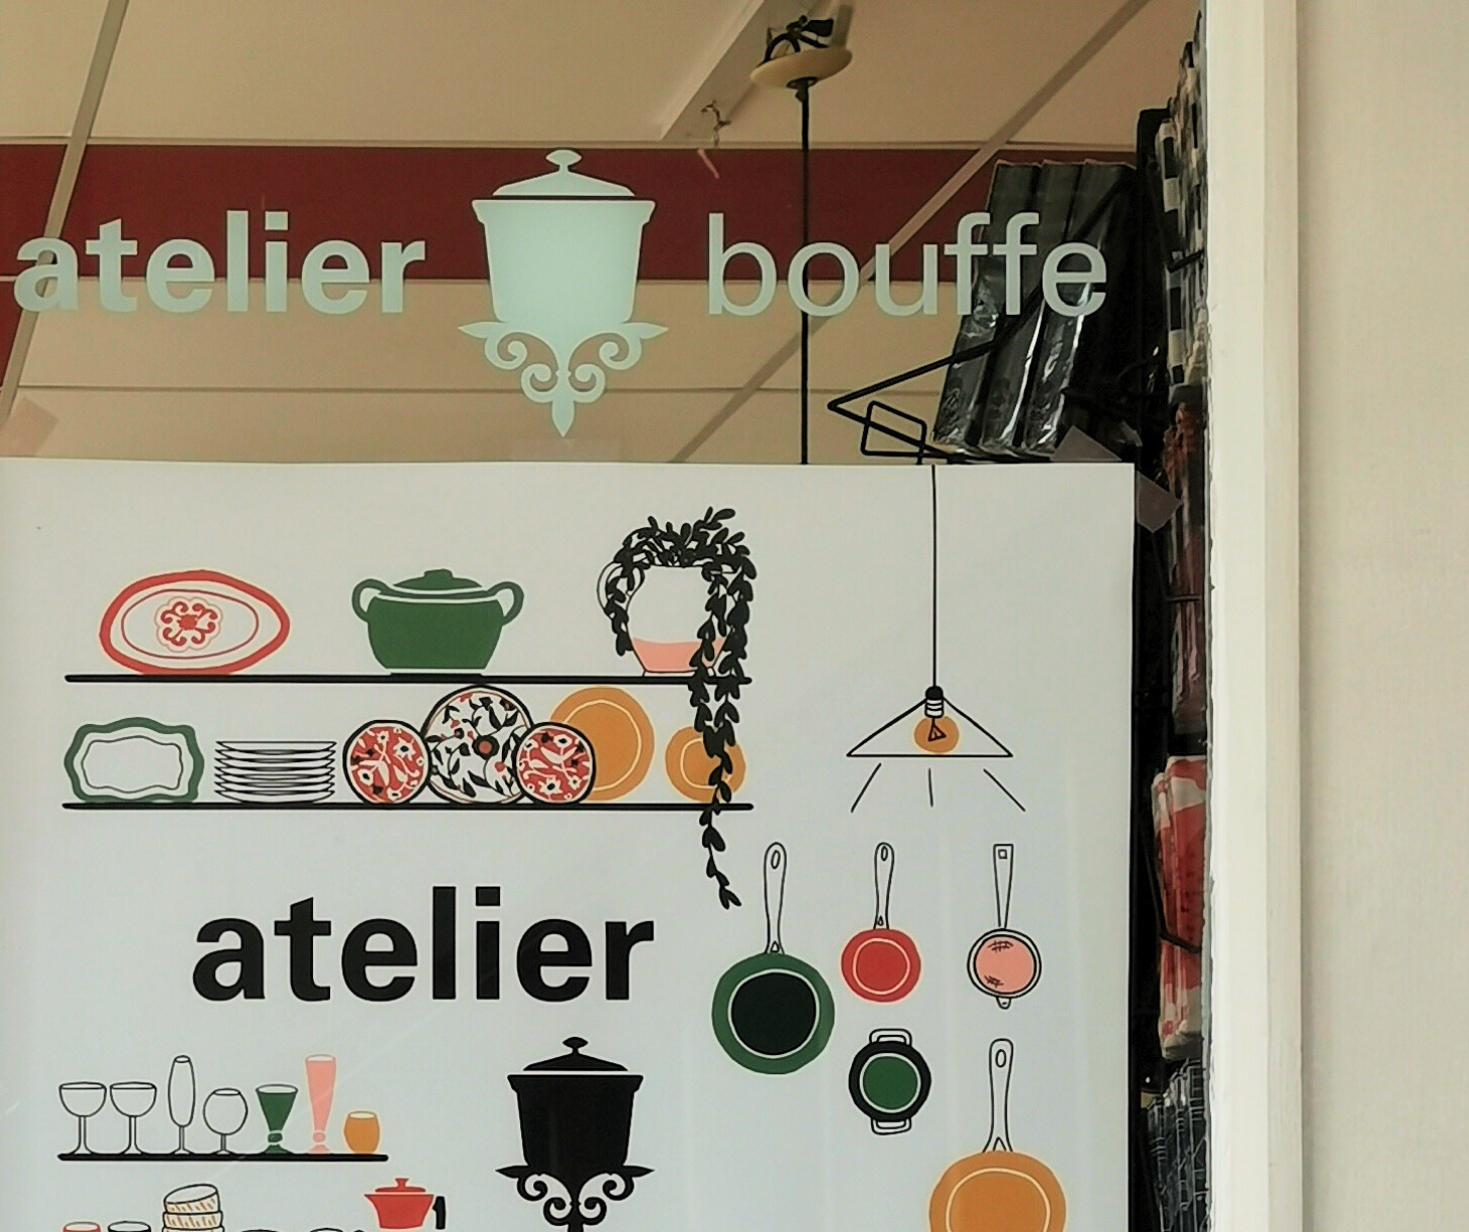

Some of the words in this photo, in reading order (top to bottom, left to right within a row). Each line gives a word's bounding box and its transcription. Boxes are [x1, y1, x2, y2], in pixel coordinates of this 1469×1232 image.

[13, 210, 426, 315] atelier
[708, 211, 1107, 317] bouffe
[193, 886, 654, 1002] atelier
